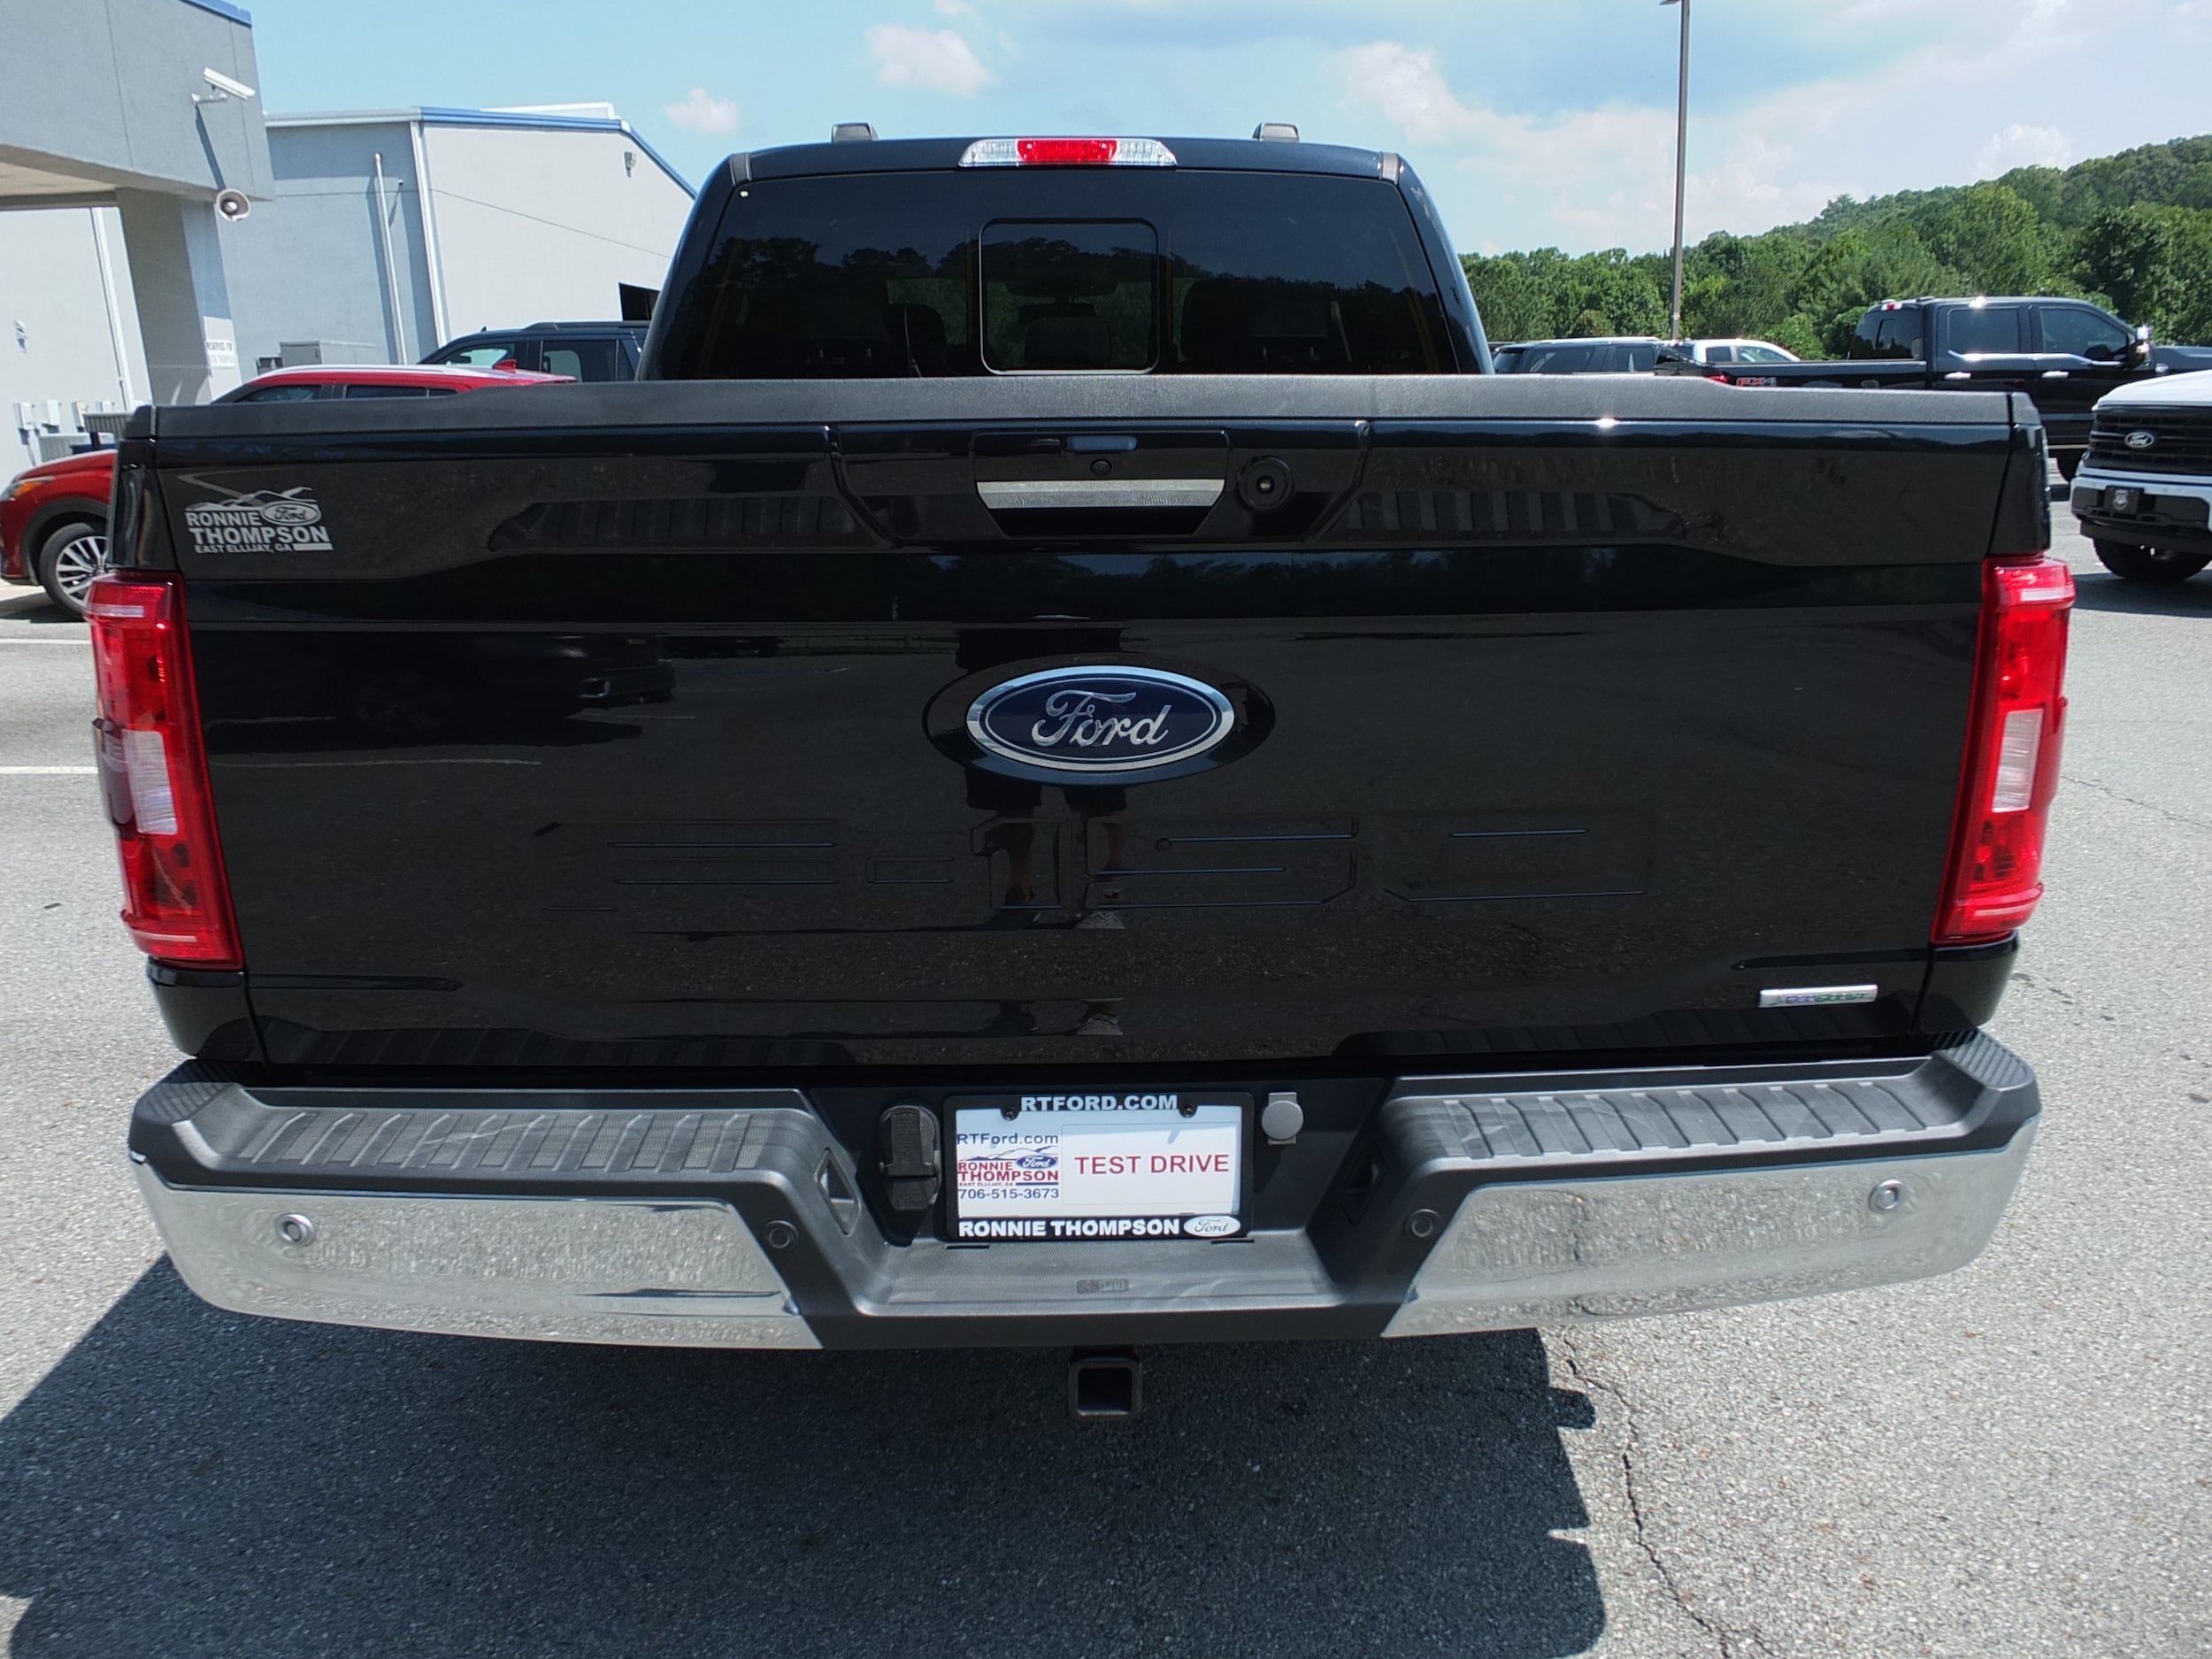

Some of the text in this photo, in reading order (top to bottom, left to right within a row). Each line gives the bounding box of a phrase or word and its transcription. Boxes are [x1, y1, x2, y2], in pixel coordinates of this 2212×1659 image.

[185, 506, 306, 526] RONNIE Ford
[188, 526, 330, 545] THOMPSON
[194, 543, 293, 554] EAST ELLIJAY, GA
[1032, 690, 1171, 746] Ford
[1020, 1095, 1179, 1111] RTFORD.COM
[956, 1133, 1059, 1145] RTFord.com
[1023, 1156, 1050, 1167] Ford
[1075, 1154, 1229, 1174] TEST DRIVE
[957, 1171, 1058, 1181] THOMPSON
[958, 1188, 1059, 1199] 706-515-3673
[959, 1218, 1229, 1237] RONNIE THOMPSON Ford
